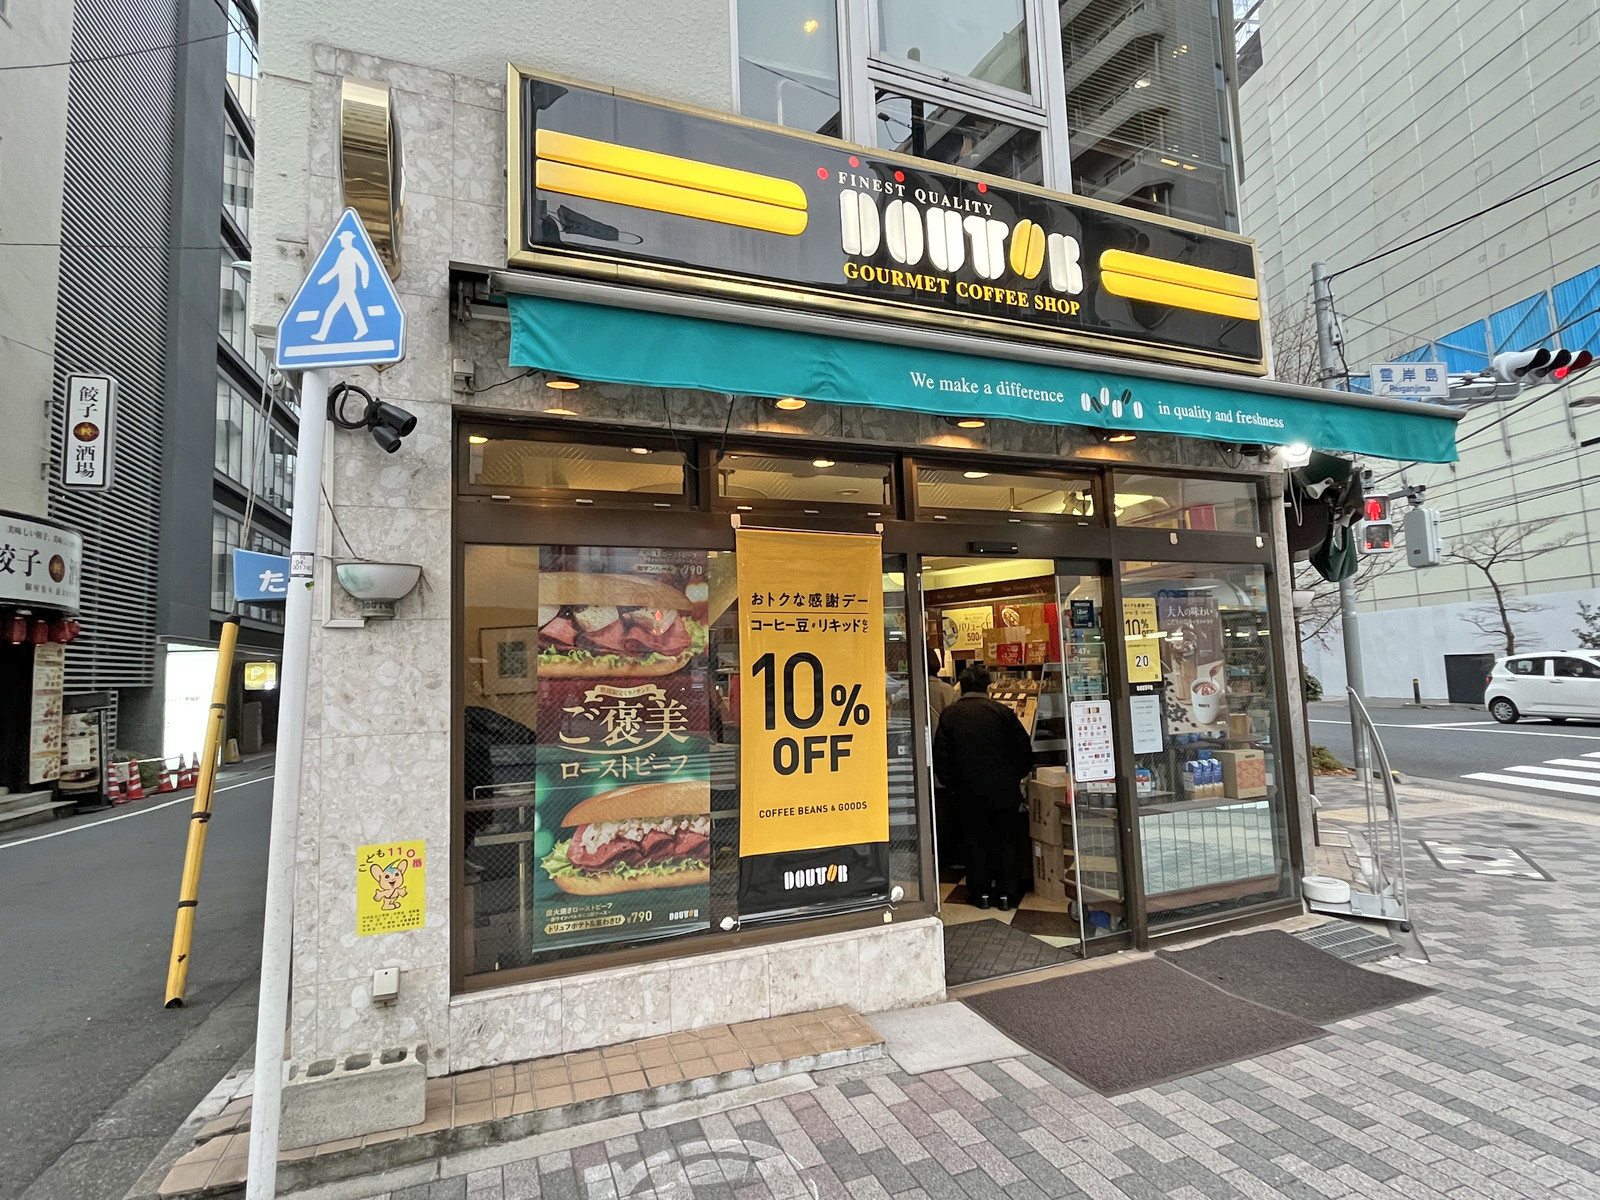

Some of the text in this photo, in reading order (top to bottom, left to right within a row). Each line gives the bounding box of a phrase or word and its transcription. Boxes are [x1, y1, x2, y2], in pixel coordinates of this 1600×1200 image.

[838, 171, 994, 216] FINEST QUALITY
[839, 188, 1084, 295] DOUTOR
[843, 261, 1081, 316] GOURMET COFFEE SHOP
[909, 370, 1285, 429] We make a difference in quality and freshness
[1389, 384, 1431, 394] Reiganjima
[75, 386, 99, 478] 餃子 酒場
[752, 592, 868, 608] おトクな感謝デー
[1167, 606, 1213, 618] 大人の味わい
[1135, 655, 1149, 668] 20
[752, 651, 871, 731] 10%
[559, 699, 690, 747] ご褒美
[561, 753, 688, 780] ローストビーフ
[773, 734, 853, 776] OFF
[759, 807, 795, 819] COFFEE
[798, 804, 828, 815] BEANS
[838, 801, 868, 812] GOODS
[784, 864, 848, 890] DOUTOR
